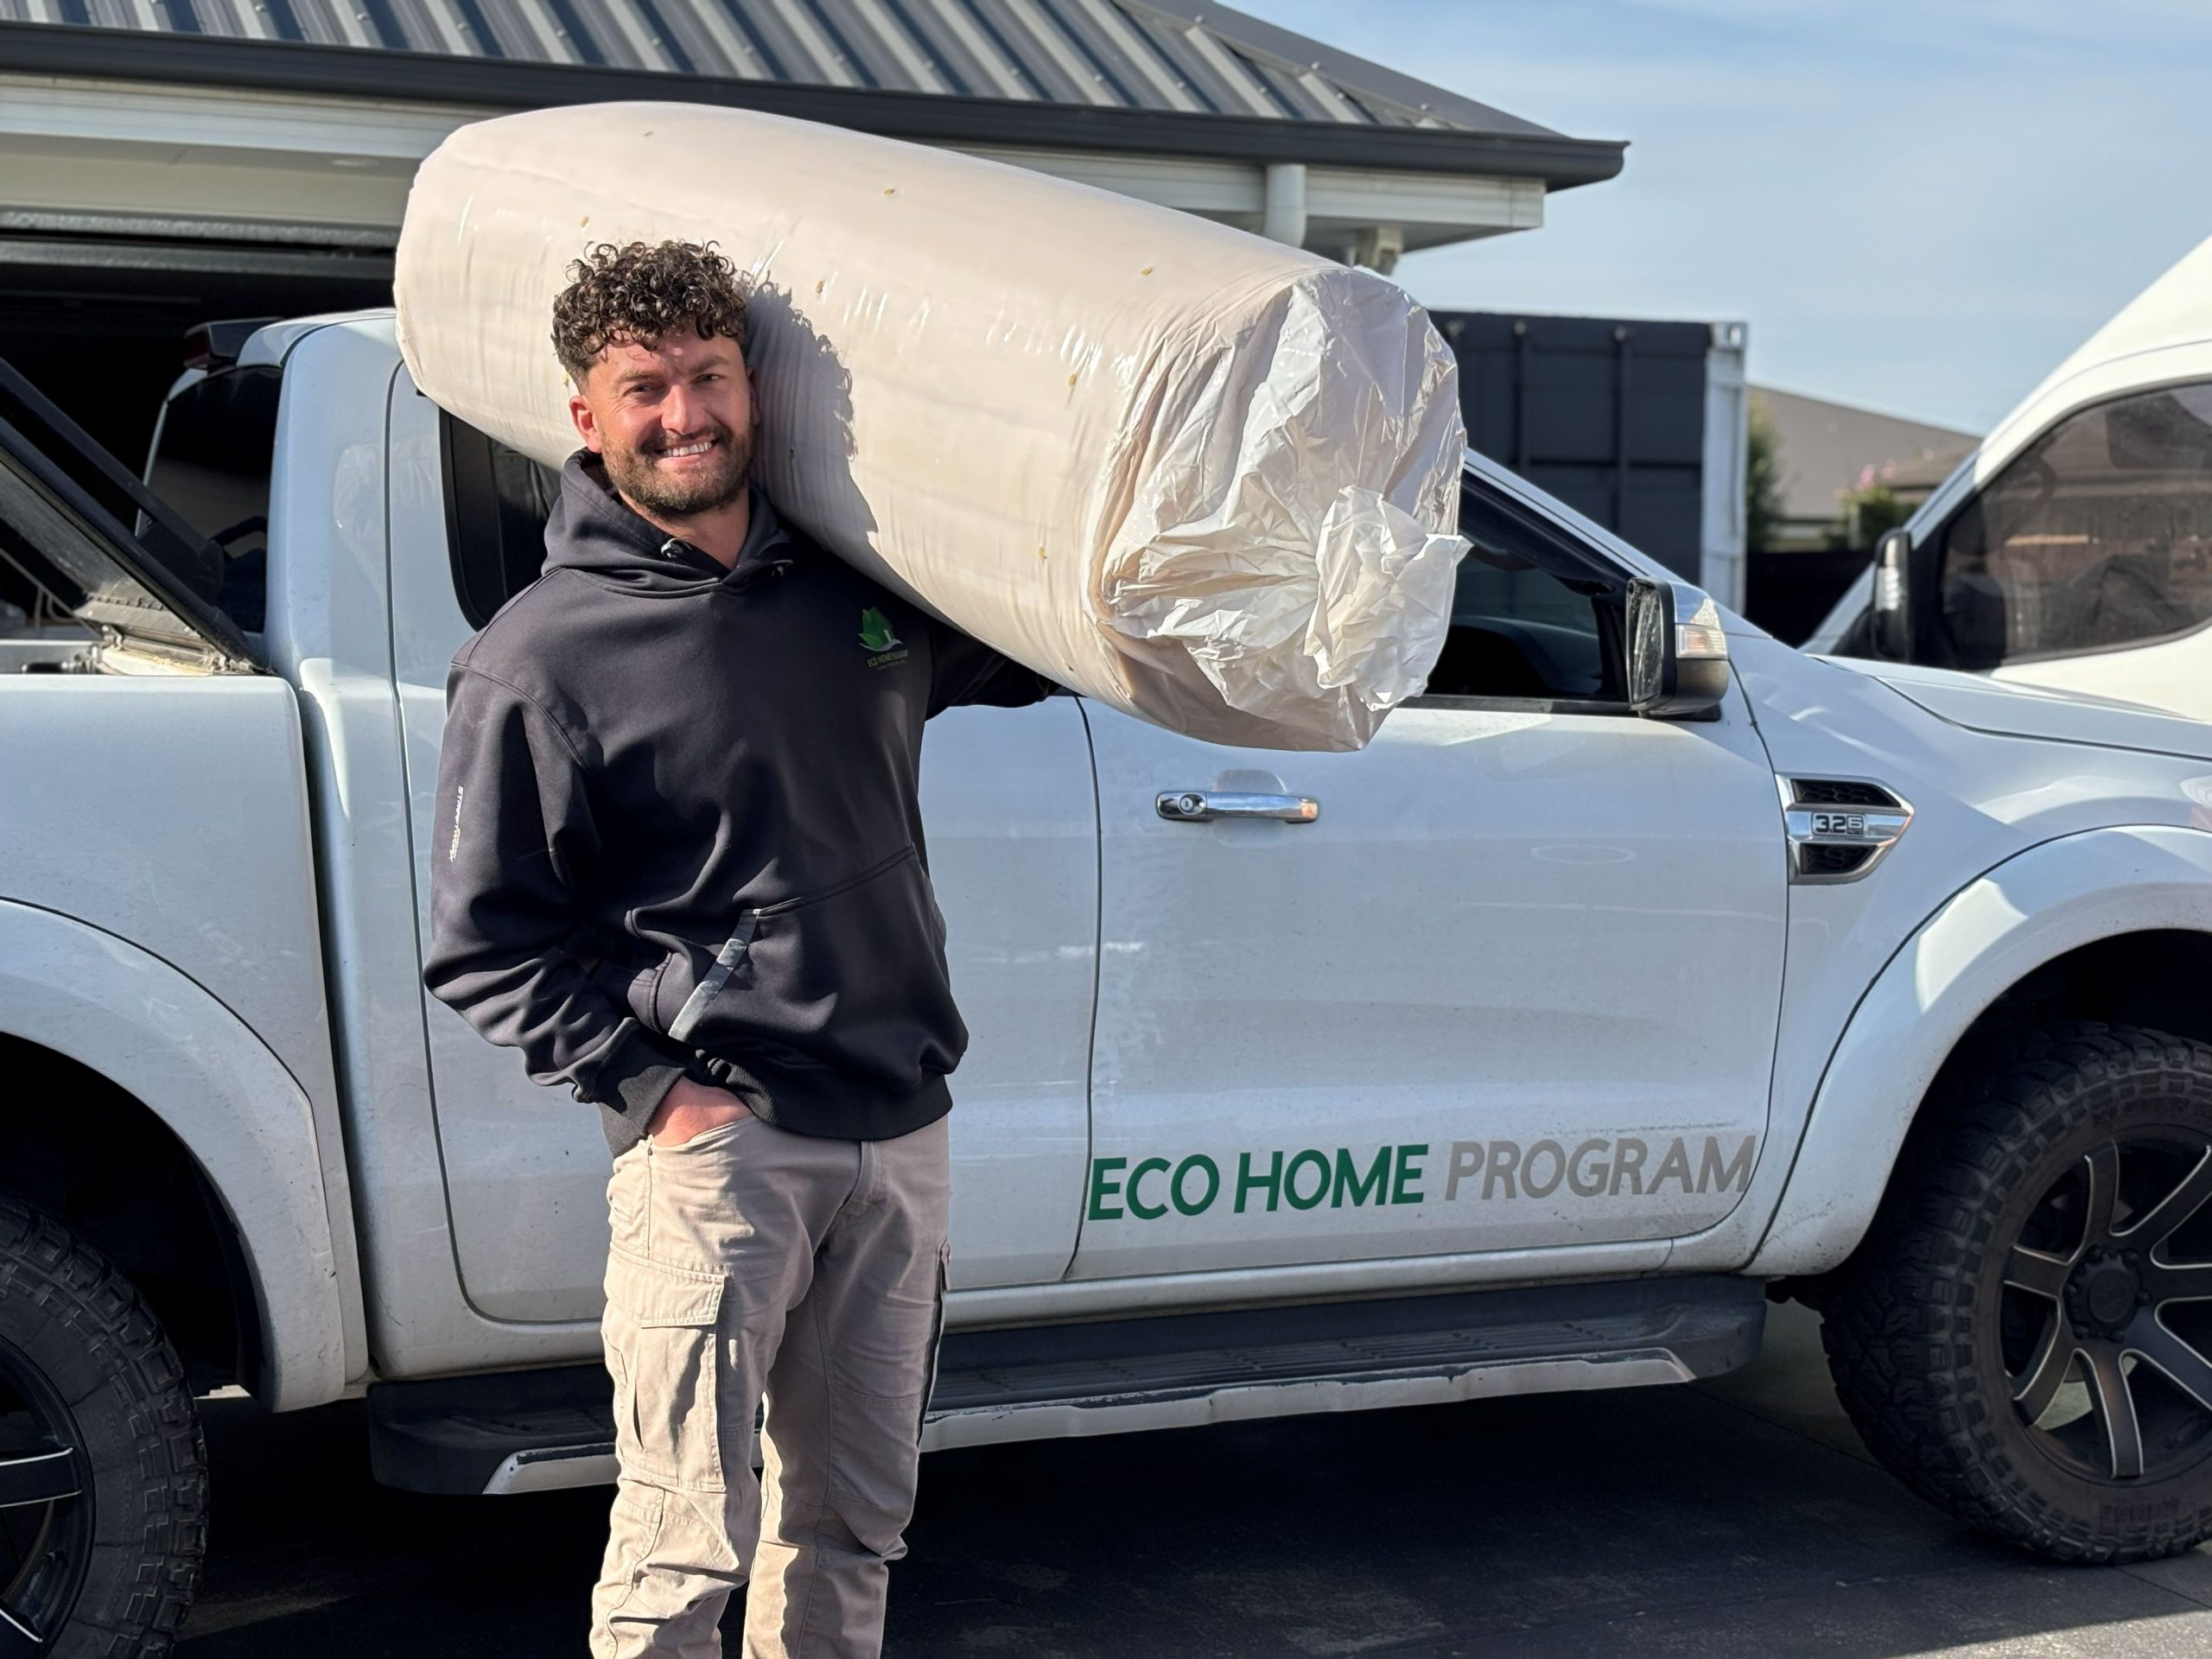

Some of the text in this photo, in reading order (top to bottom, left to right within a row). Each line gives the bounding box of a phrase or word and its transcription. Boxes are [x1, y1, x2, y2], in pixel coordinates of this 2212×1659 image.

[1088, 1135, 1757, 1221] ECO HOME PROGRAM
